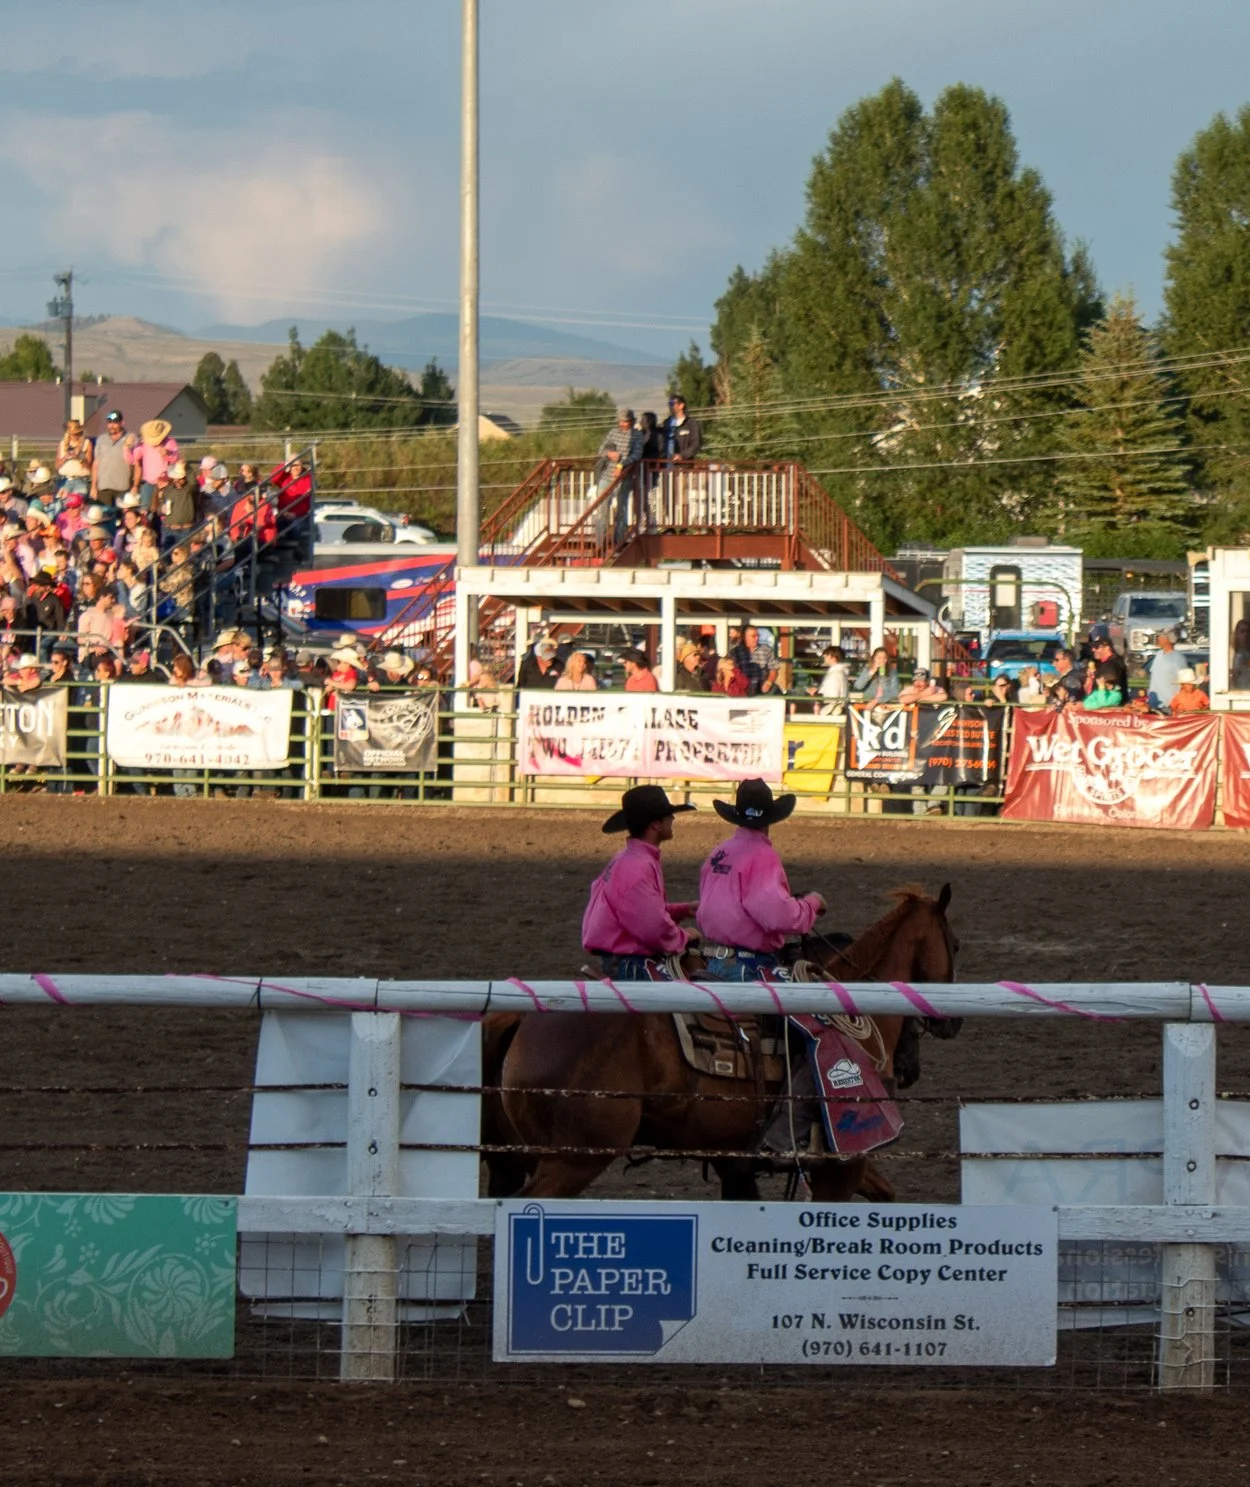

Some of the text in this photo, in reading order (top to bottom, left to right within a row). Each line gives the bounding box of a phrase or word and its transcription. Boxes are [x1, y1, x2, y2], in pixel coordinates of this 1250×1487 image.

[124, 692, 184, 721] GUNSON
[186, 690, 252, 712] MERIALS
[529, 704, 606, 727] HOLDEN
[1067, 713, 1132, 728] Sponsored
[971, 730, 996, 740] BUTE
[654, 739, 772, 768] PROPERTIE
[1026, 732, 1197, 770] Wet Grocer
[799, 1211, 957, 1234] Office Supplies
[551, 1233, 625, 1258] THE
[711, 1237, 1043, 1259] Cleaning/Break Room Products
[550, 1269, 671, 1295] PAPER
[747, 1263, 1007, 1285] Full Service Copy Center
[551, 1304, 633, 1331] CLIP
[772, 1314, 980, 1332] 107 N. Wisconsin St.
[801, 1341, 947, 1359] (970) 641-1107
